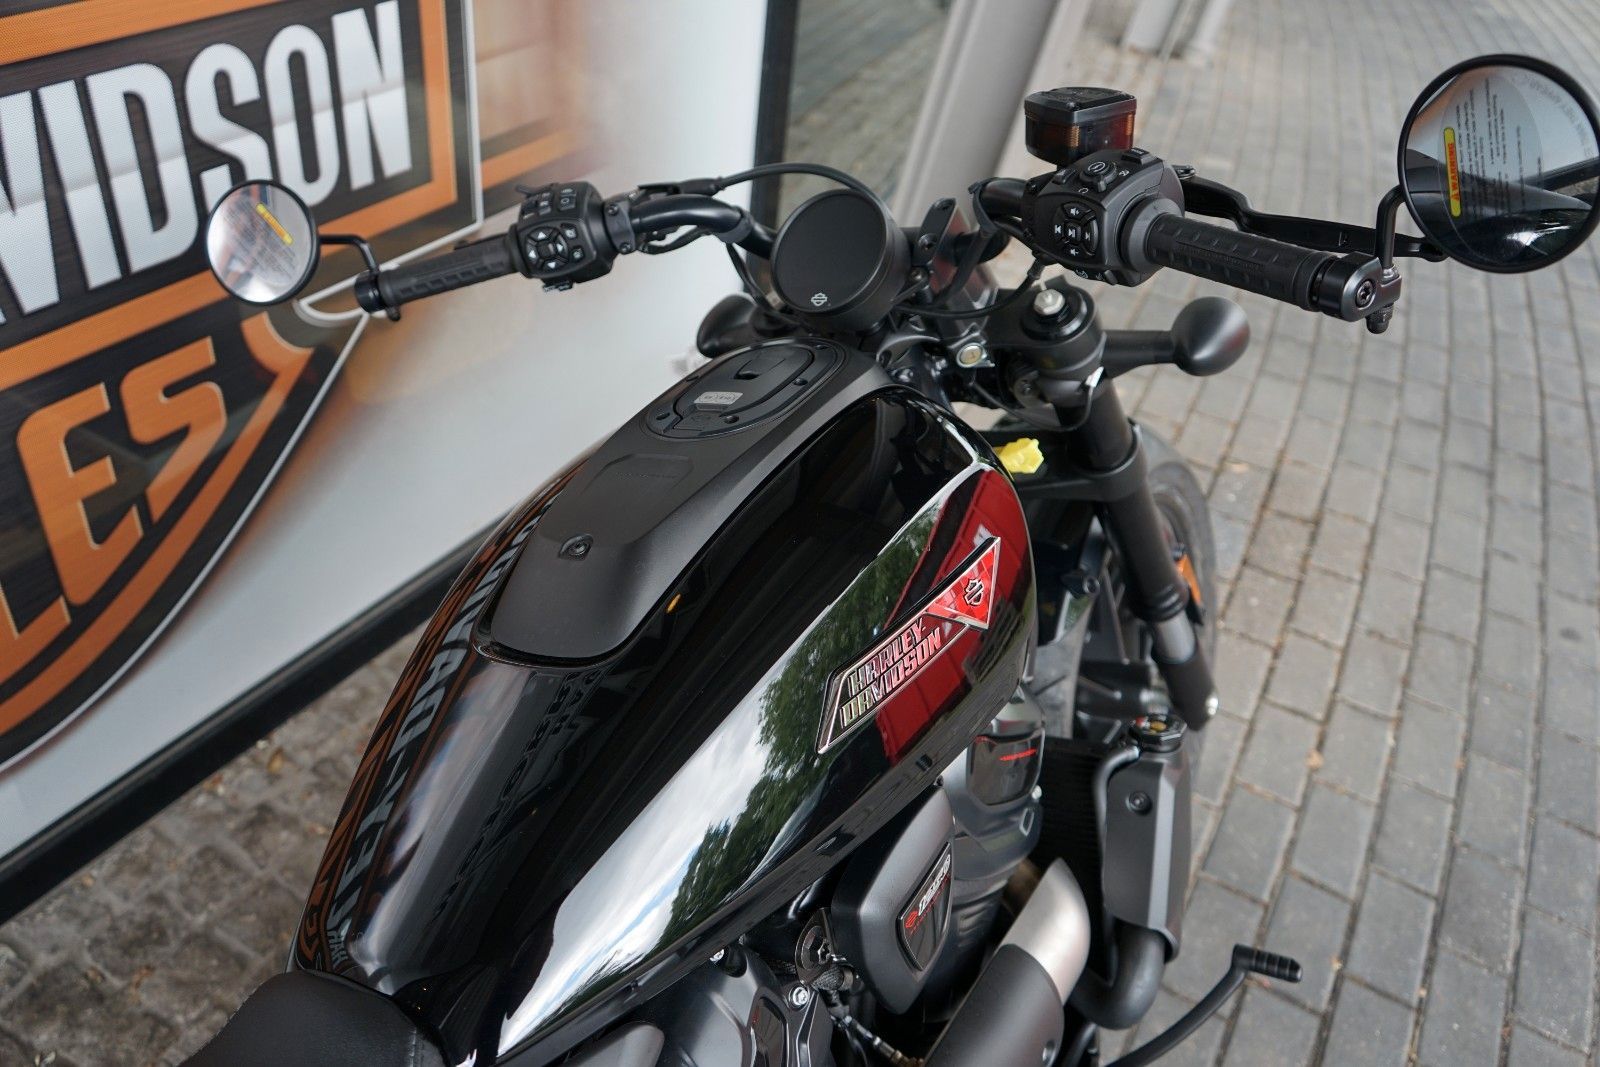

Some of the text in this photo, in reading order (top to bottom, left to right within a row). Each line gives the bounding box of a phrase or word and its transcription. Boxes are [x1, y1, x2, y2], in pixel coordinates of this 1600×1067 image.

[0, 0, 412, 326] VIDSON
[1448, 143, 1460, 190] WARNING
[840, 627, 942, 729] DAVIDSON
